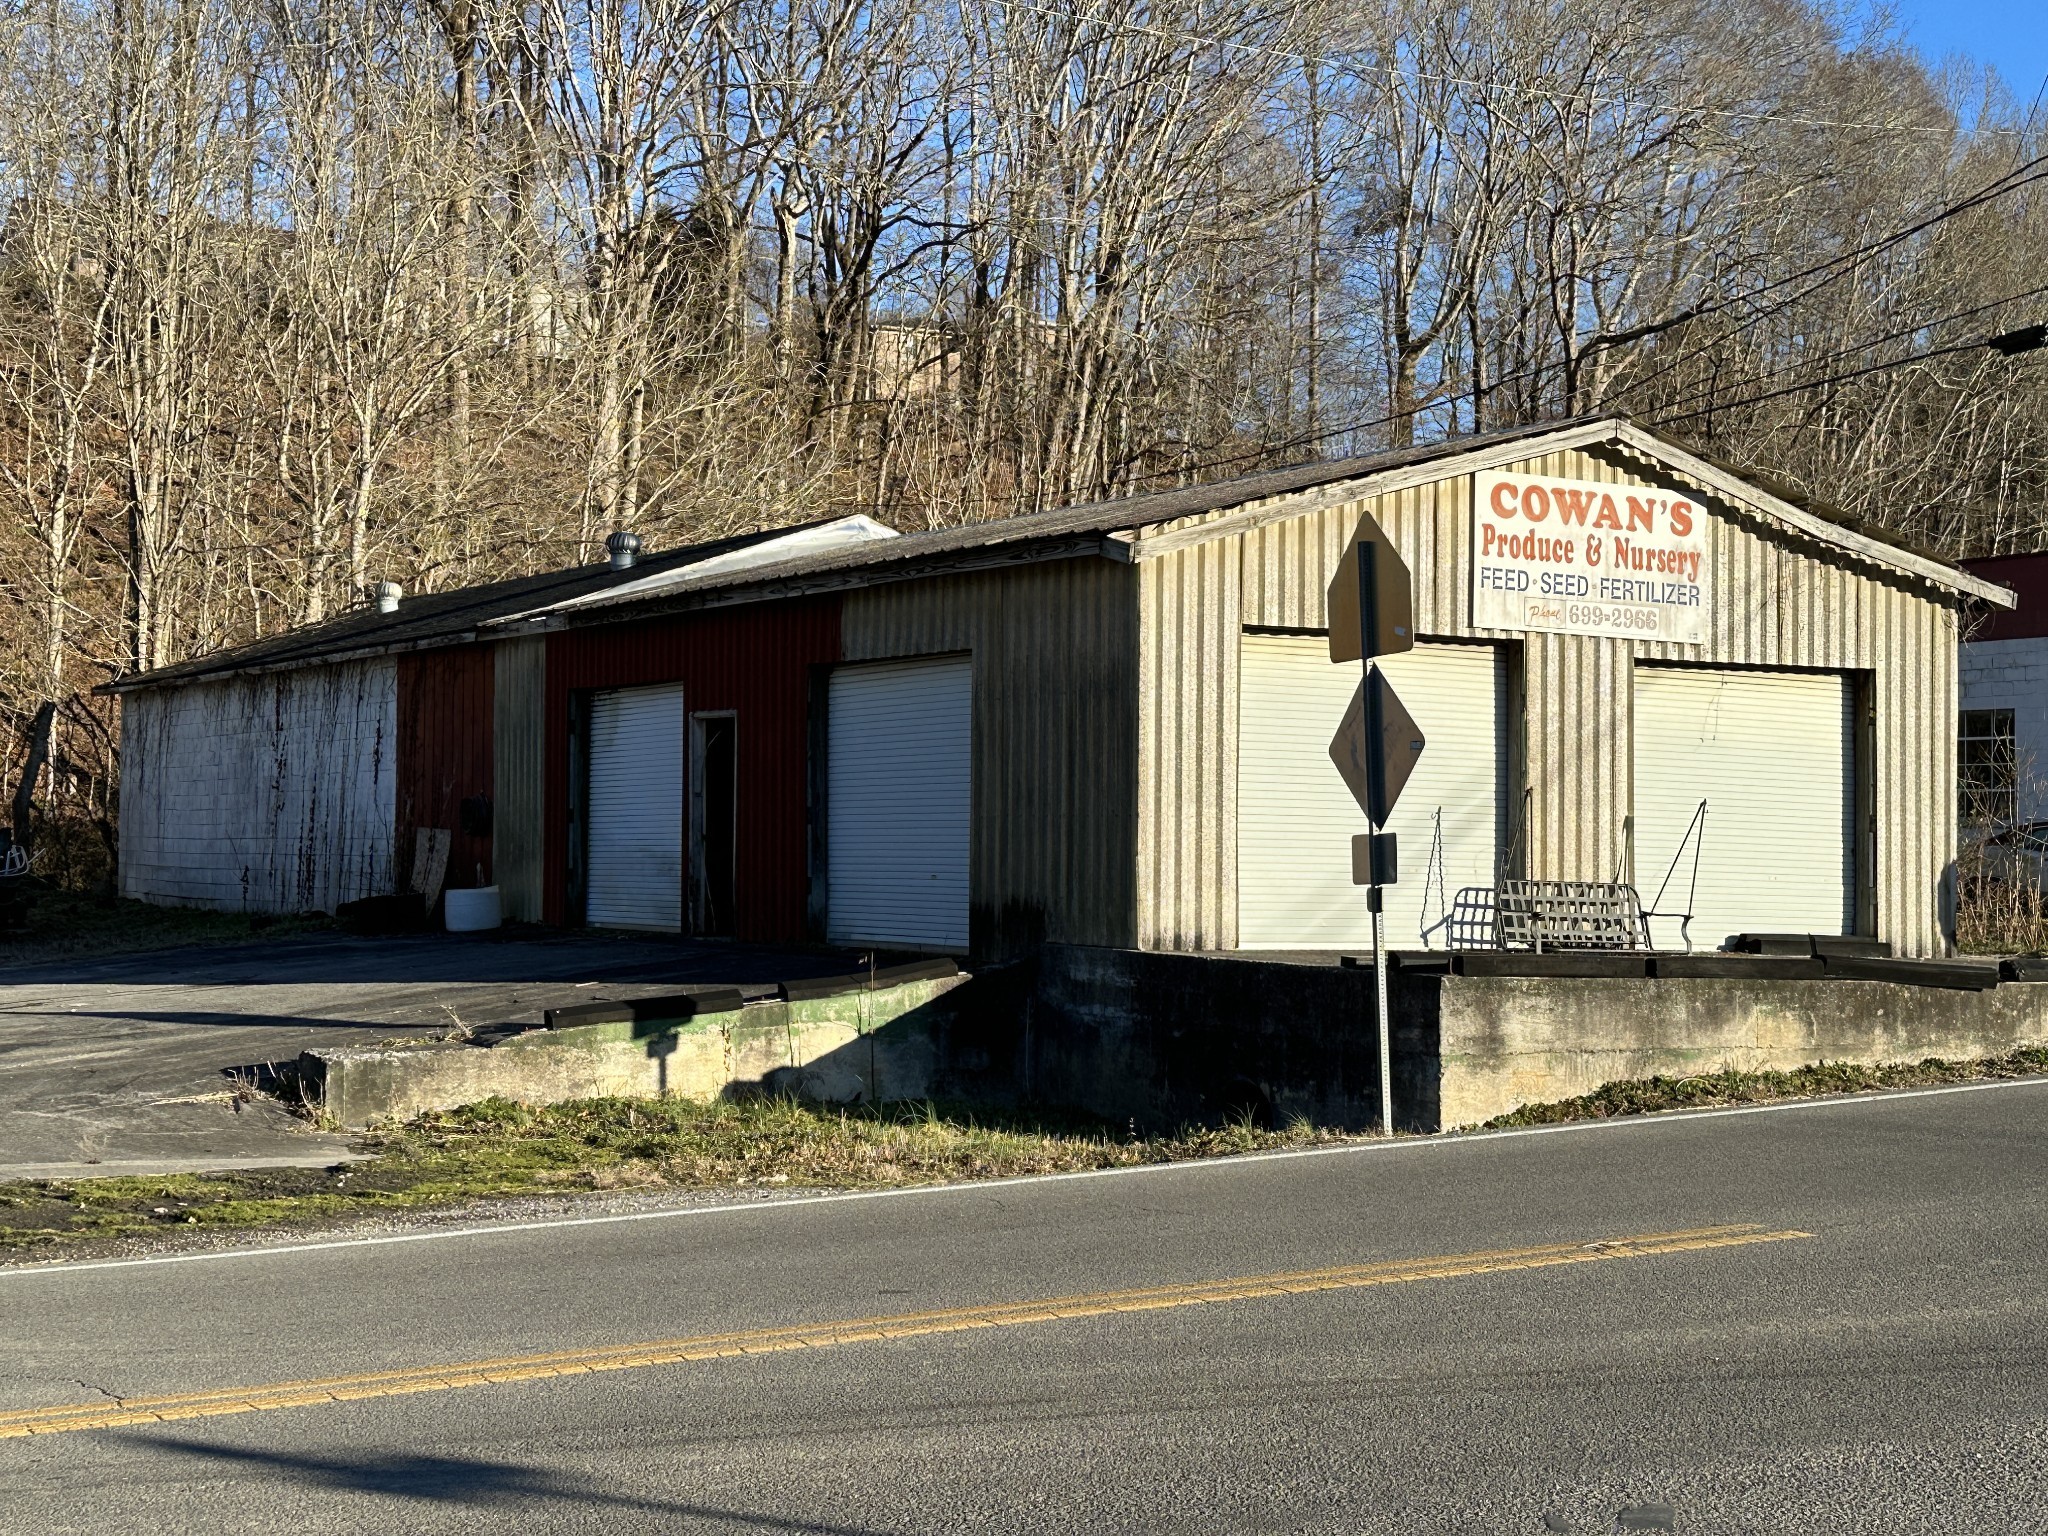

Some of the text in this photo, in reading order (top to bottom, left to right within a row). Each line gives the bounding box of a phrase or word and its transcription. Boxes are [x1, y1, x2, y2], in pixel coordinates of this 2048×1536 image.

[1490, 481, 1693, 537] COWAN'S
[1481, 523, 1701, 583] Produce & Nursery
[1480, 566, 1700, 607] FEED SEED FERTILIZER
[1568, 604, 1658, 631] 699-2966
